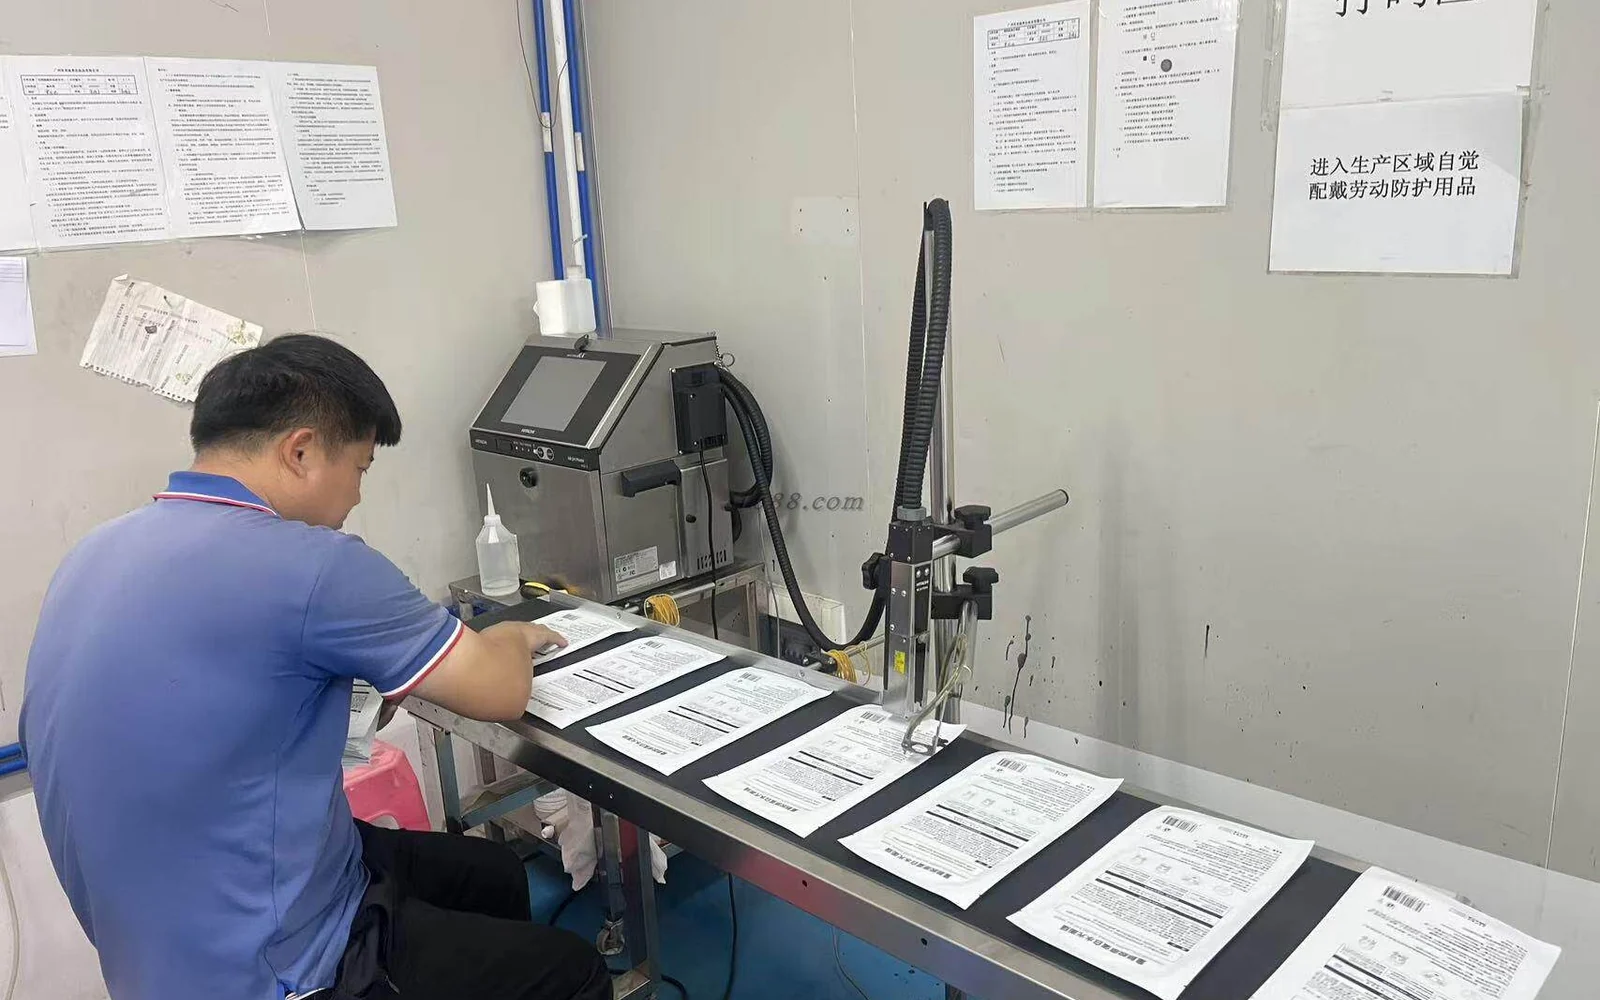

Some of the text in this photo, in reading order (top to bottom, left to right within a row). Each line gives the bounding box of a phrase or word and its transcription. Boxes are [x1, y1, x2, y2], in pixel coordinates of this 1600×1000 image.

[1310, 150, 1480, 176] 进入生产区域自觉
[1309, 176, 1476, 200] 配戴劳动防护用品
